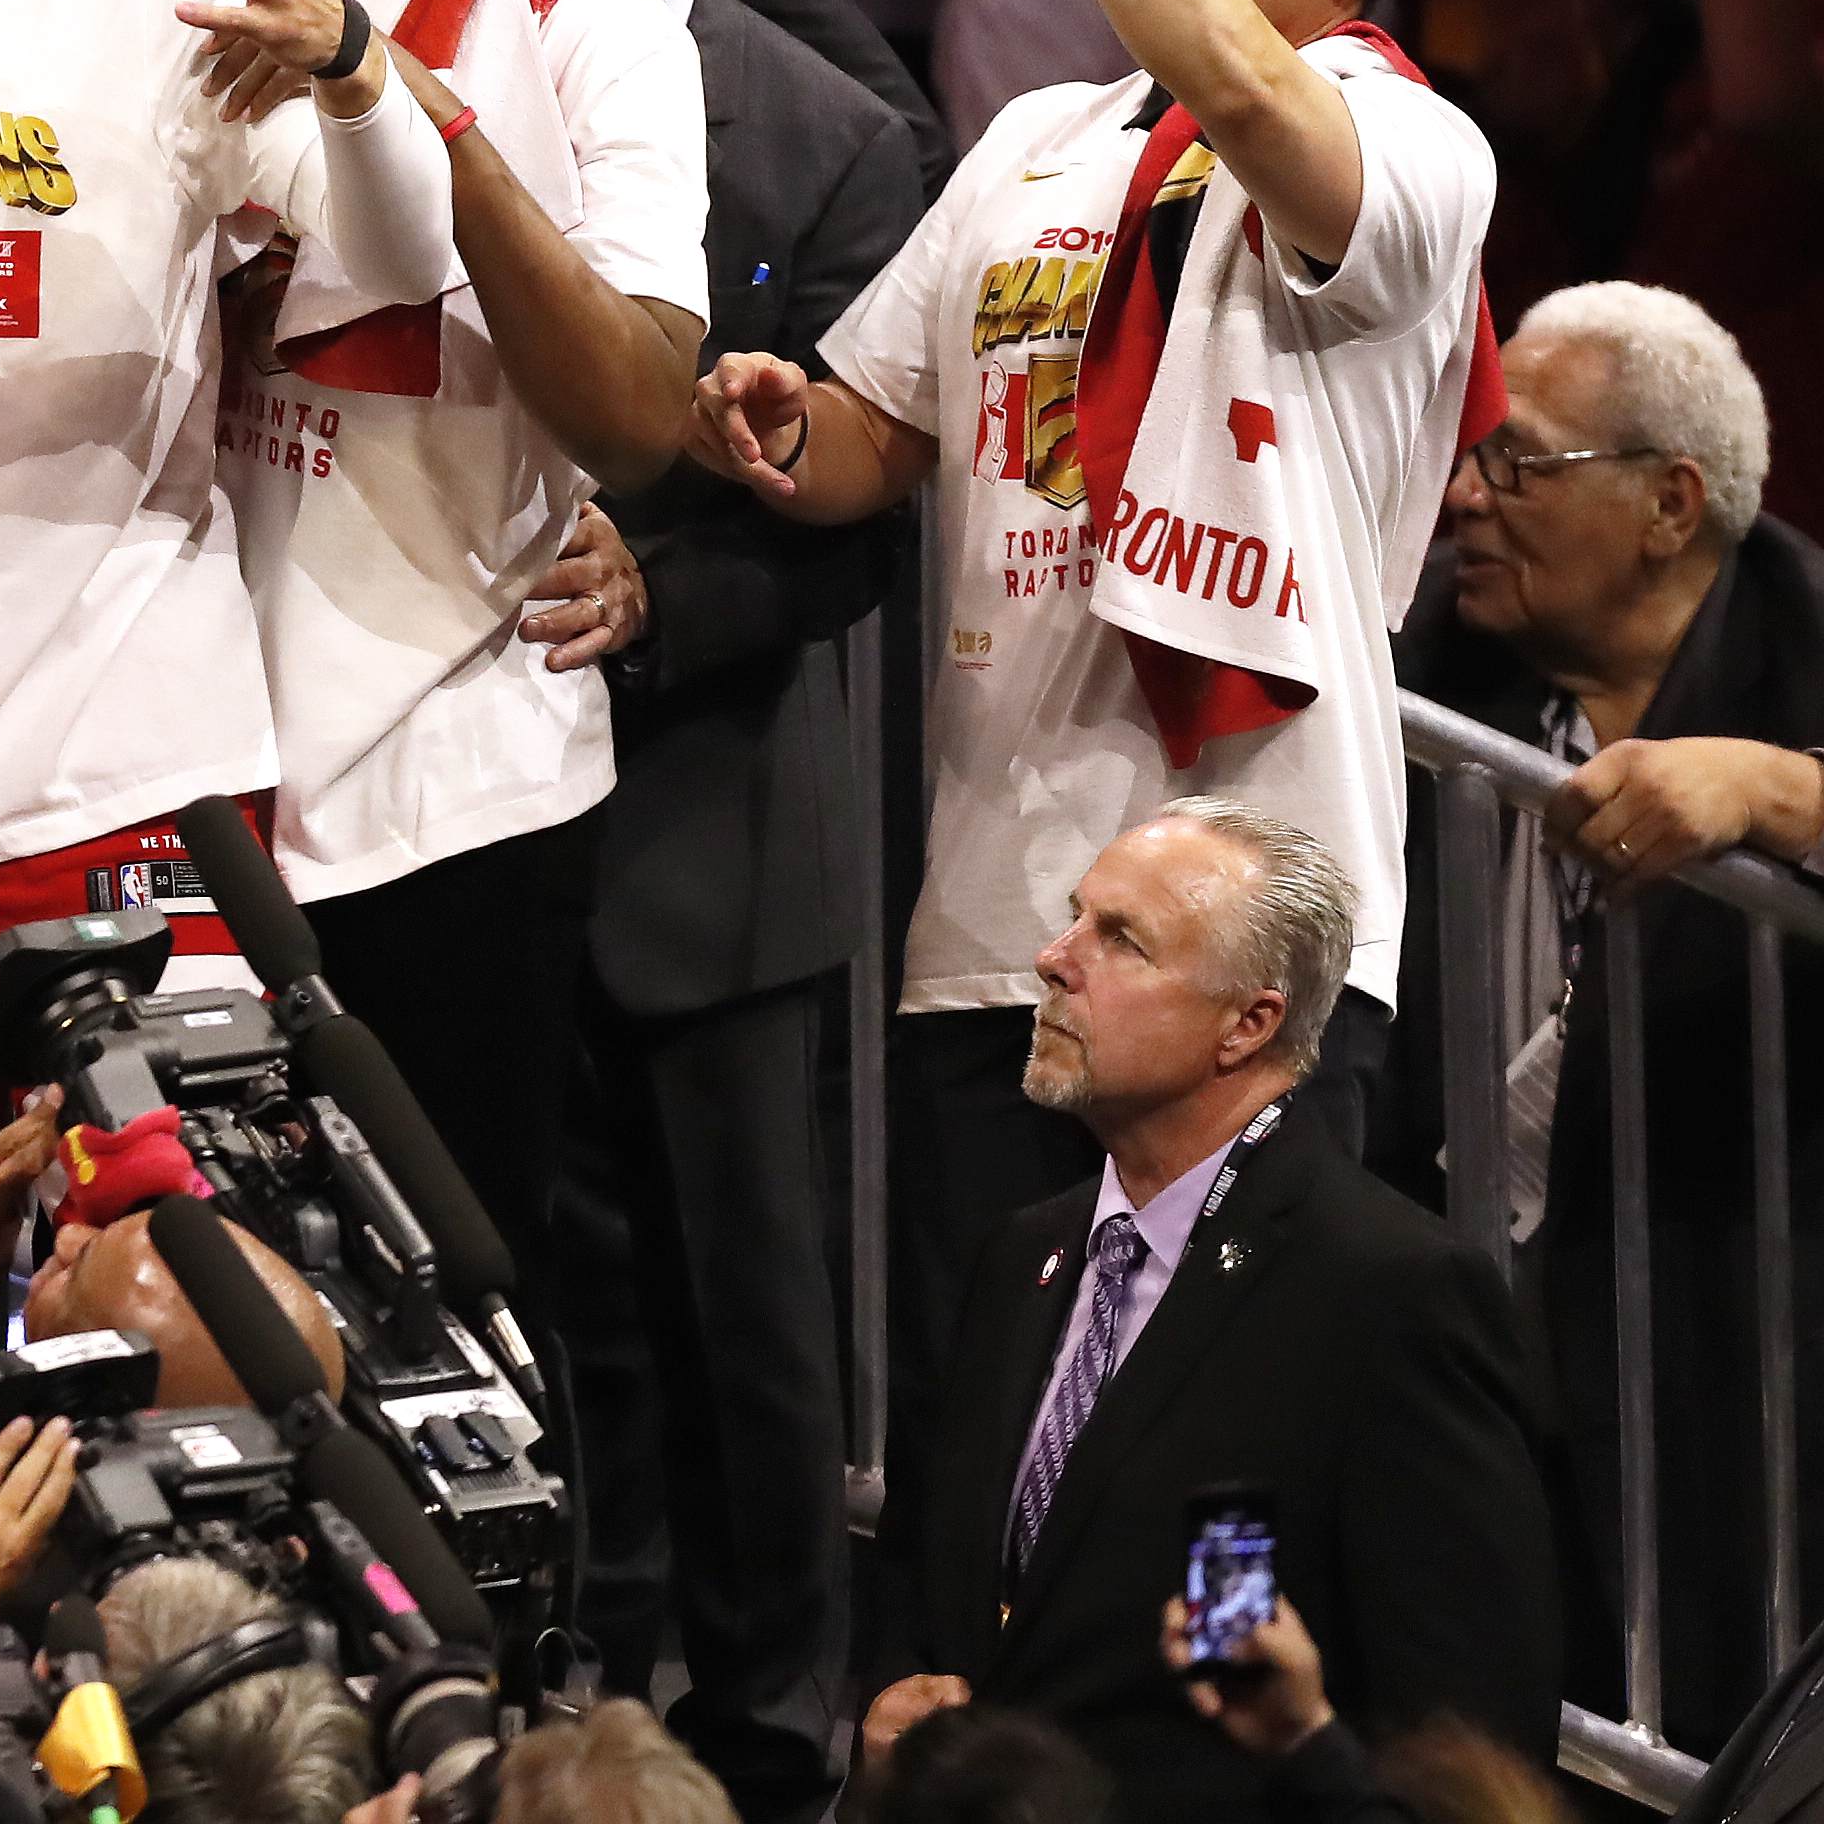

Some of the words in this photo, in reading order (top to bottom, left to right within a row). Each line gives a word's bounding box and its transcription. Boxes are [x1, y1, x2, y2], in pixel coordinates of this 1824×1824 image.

[139, 836, 160, 849] WE
[161, 834, 187, 849] TH
[155, 875, 169, 886] 50
[1213, 1164, 1240, 1197] FINALS
